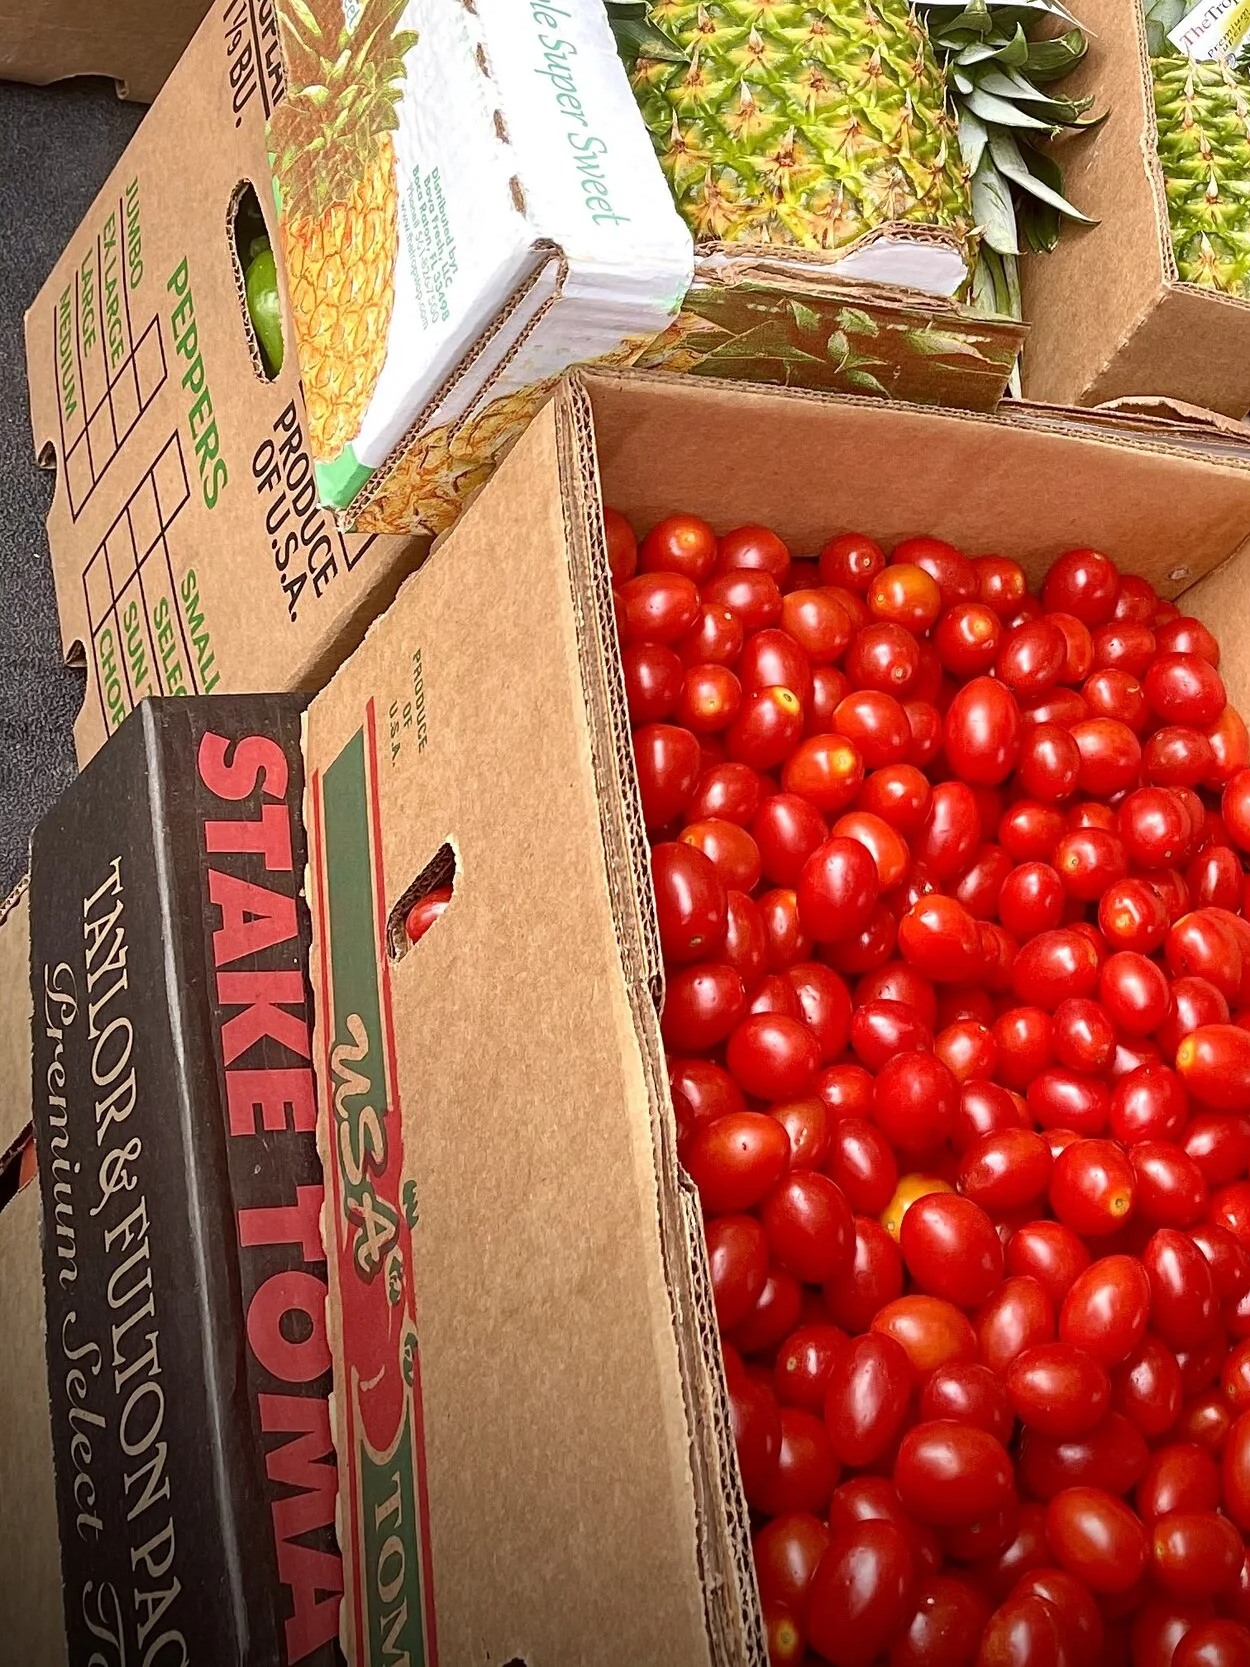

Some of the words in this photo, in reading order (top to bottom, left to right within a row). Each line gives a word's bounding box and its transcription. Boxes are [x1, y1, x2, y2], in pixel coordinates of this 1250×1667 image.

[229, 39, 257, 128] BU.
[1208, 8, 1249, 58] Premium
[412, 164, 423, 202] Boca
[534, 34, 588, 128] Super
[567, 132, 631, 226] Sweet
[125, 175, 143, 291] JUMBO
[432, 166, 454, 246] Distributed
[59, 284, 77, 422] MEDIUM
[80, 247, 97, 357] LARGE
[107, 257, 125, 369] LARGE
[167, 256, 229, 509] PEPPERS
[252, 441, 282, 496] OF
[273, 398, 338, 598] PRODUCE
[266, 505, 298, 623] U.S.A.
[124, 601, 148, 688] SUN
[402, 703, 413, 729] OF
[412, 648, 429, 755] PRODUCE
[197, 731, 317, 1137] STAKE
[84, 856, 138, 1146] TAYLOR
[90, 1137, 142, 1216] &
[44, 962, 80, 1291] Premium
[62, 1310, 106, 1543] Select
[104, 1195, 172, 1522] FULTON
